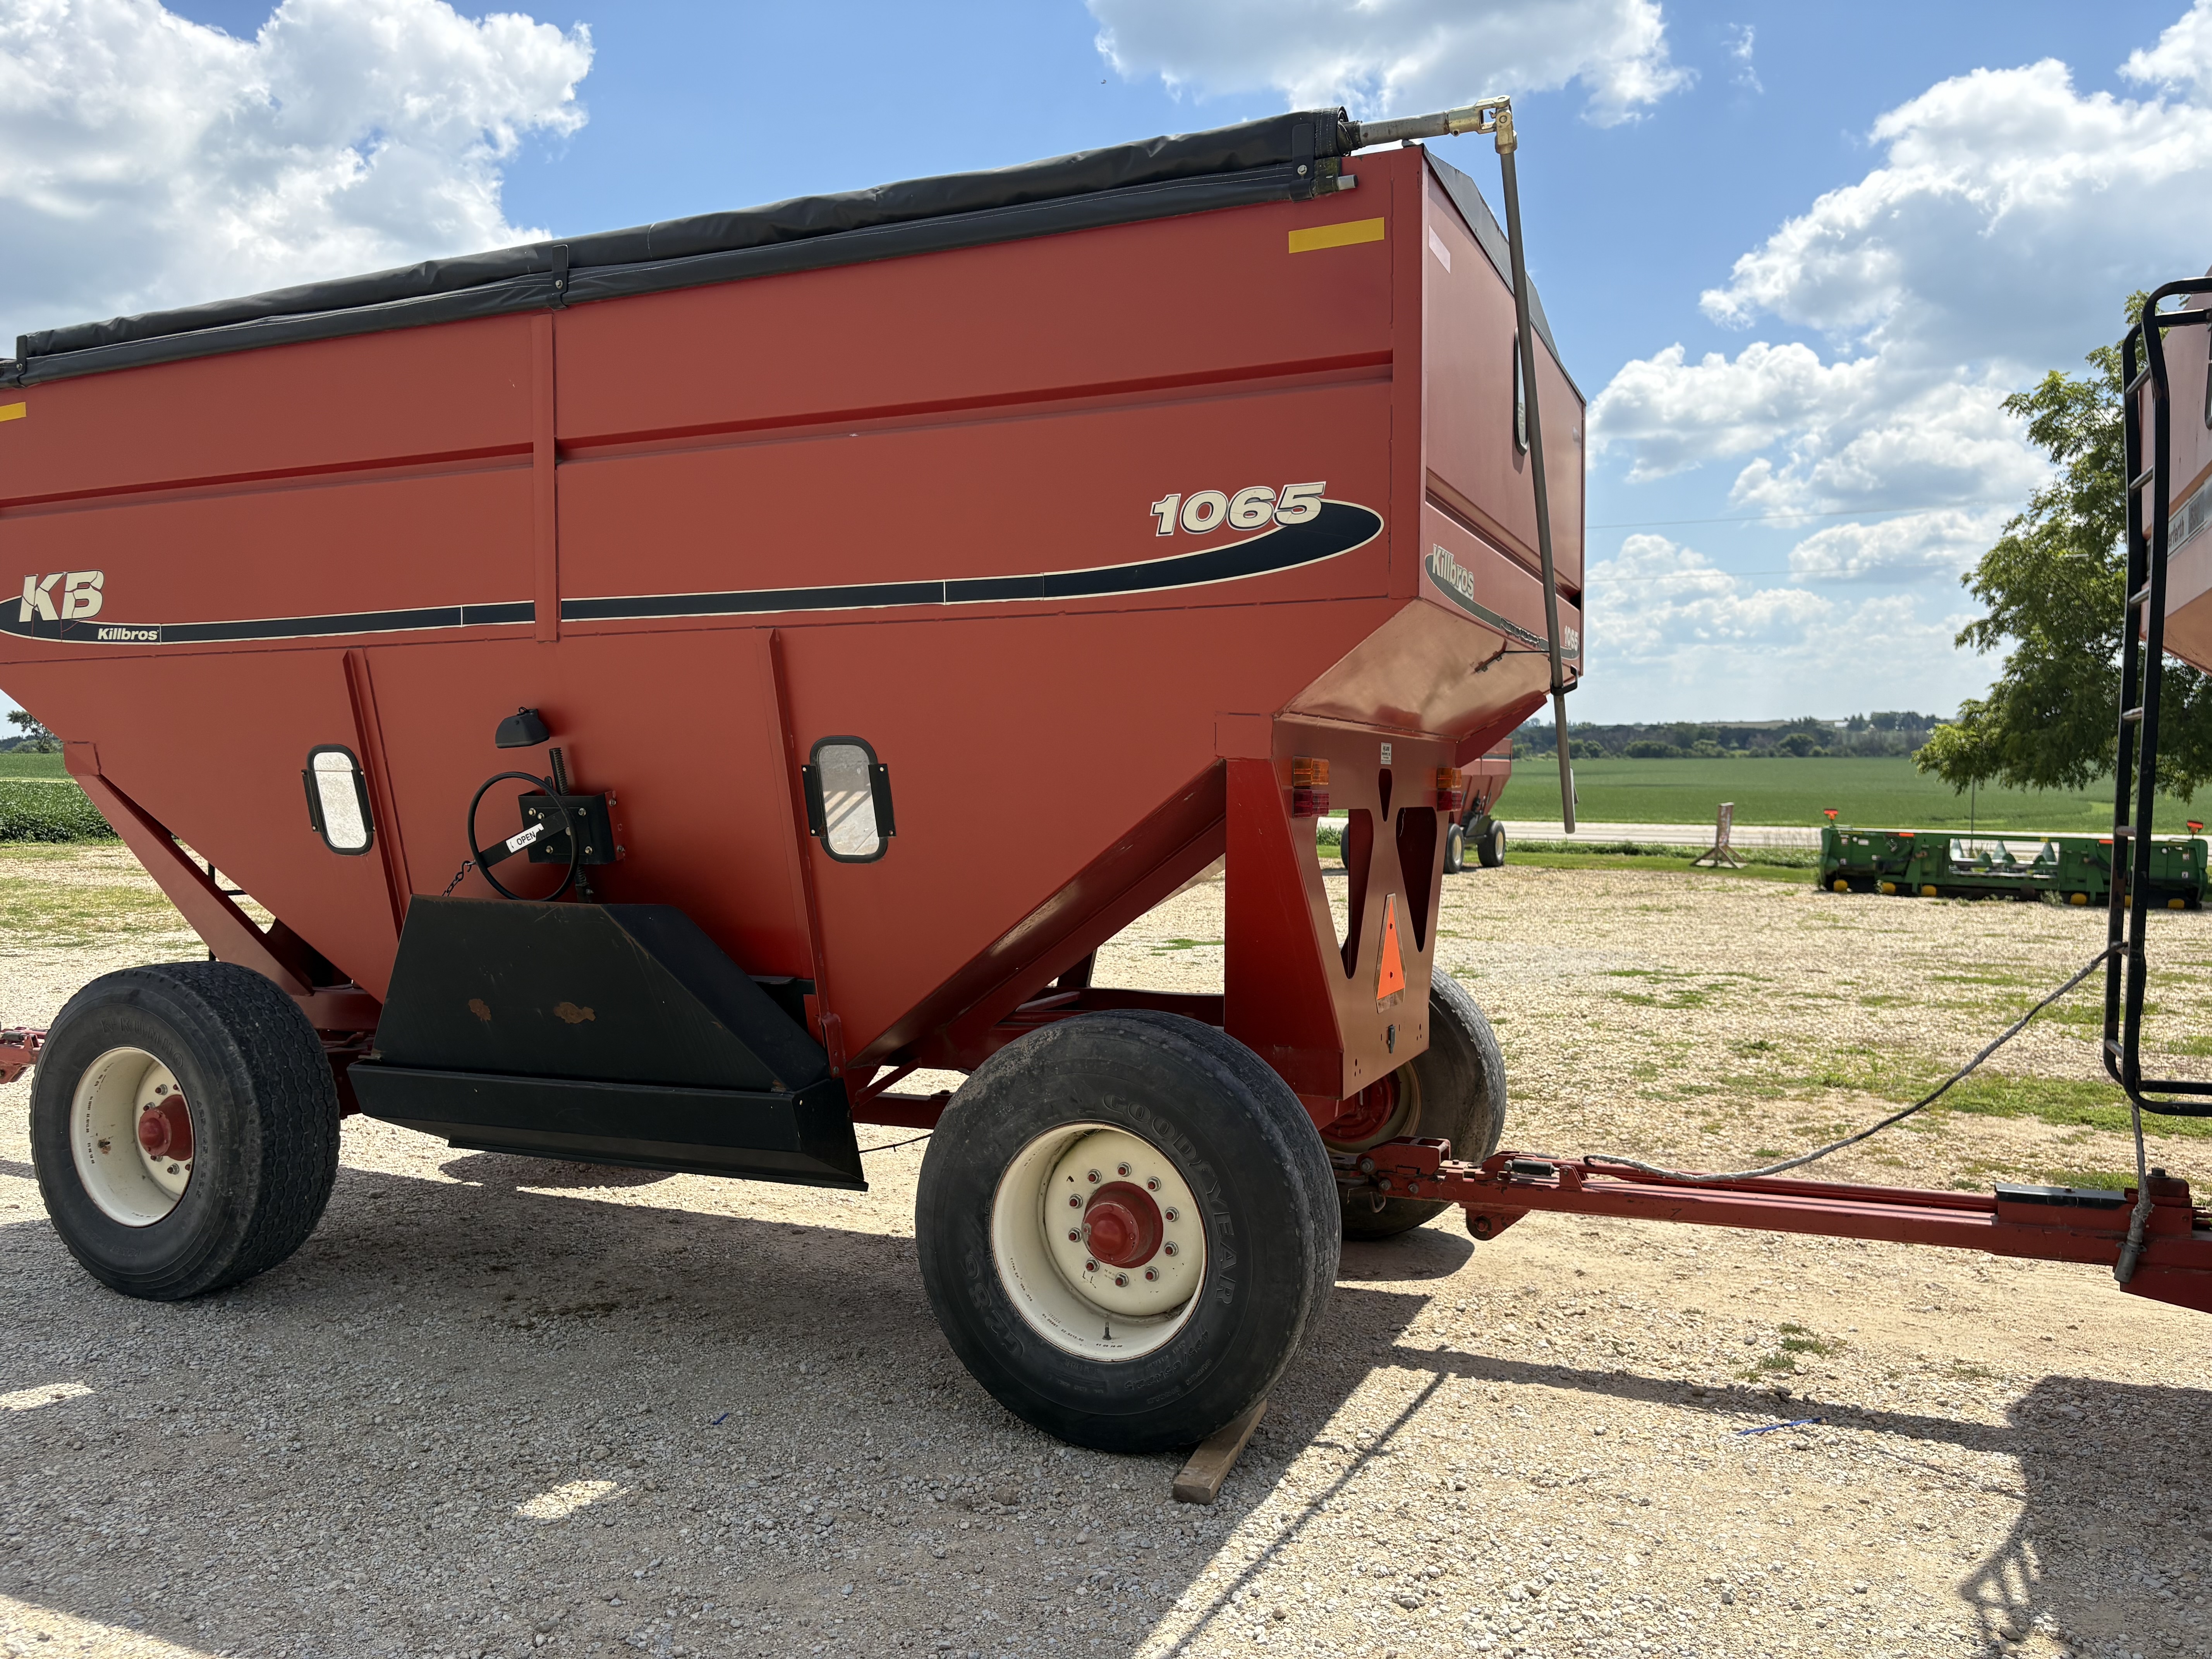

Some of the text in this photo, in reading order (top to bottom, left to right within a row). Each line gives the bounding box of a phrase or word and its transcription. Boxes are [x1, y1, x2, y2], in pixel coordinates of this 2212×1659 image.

[1150, 481, 1326, 537] 1065
[2168, 515, 2184, 548] erferth
[19, 569, 105, 622] KB
[1432, 544, 1474, 597] Killbros
[98, 628, 158, 641] Killbros
[1565, 625, 1579, 651] 1065
[517, 831, 536, 845] OPEN
[1103, 1092, 1238, 1304] GOODYEAR
[960, 1253, 1024, 1358] G286
[1124, 1329, 1209, 1392] 425/65R22.5
